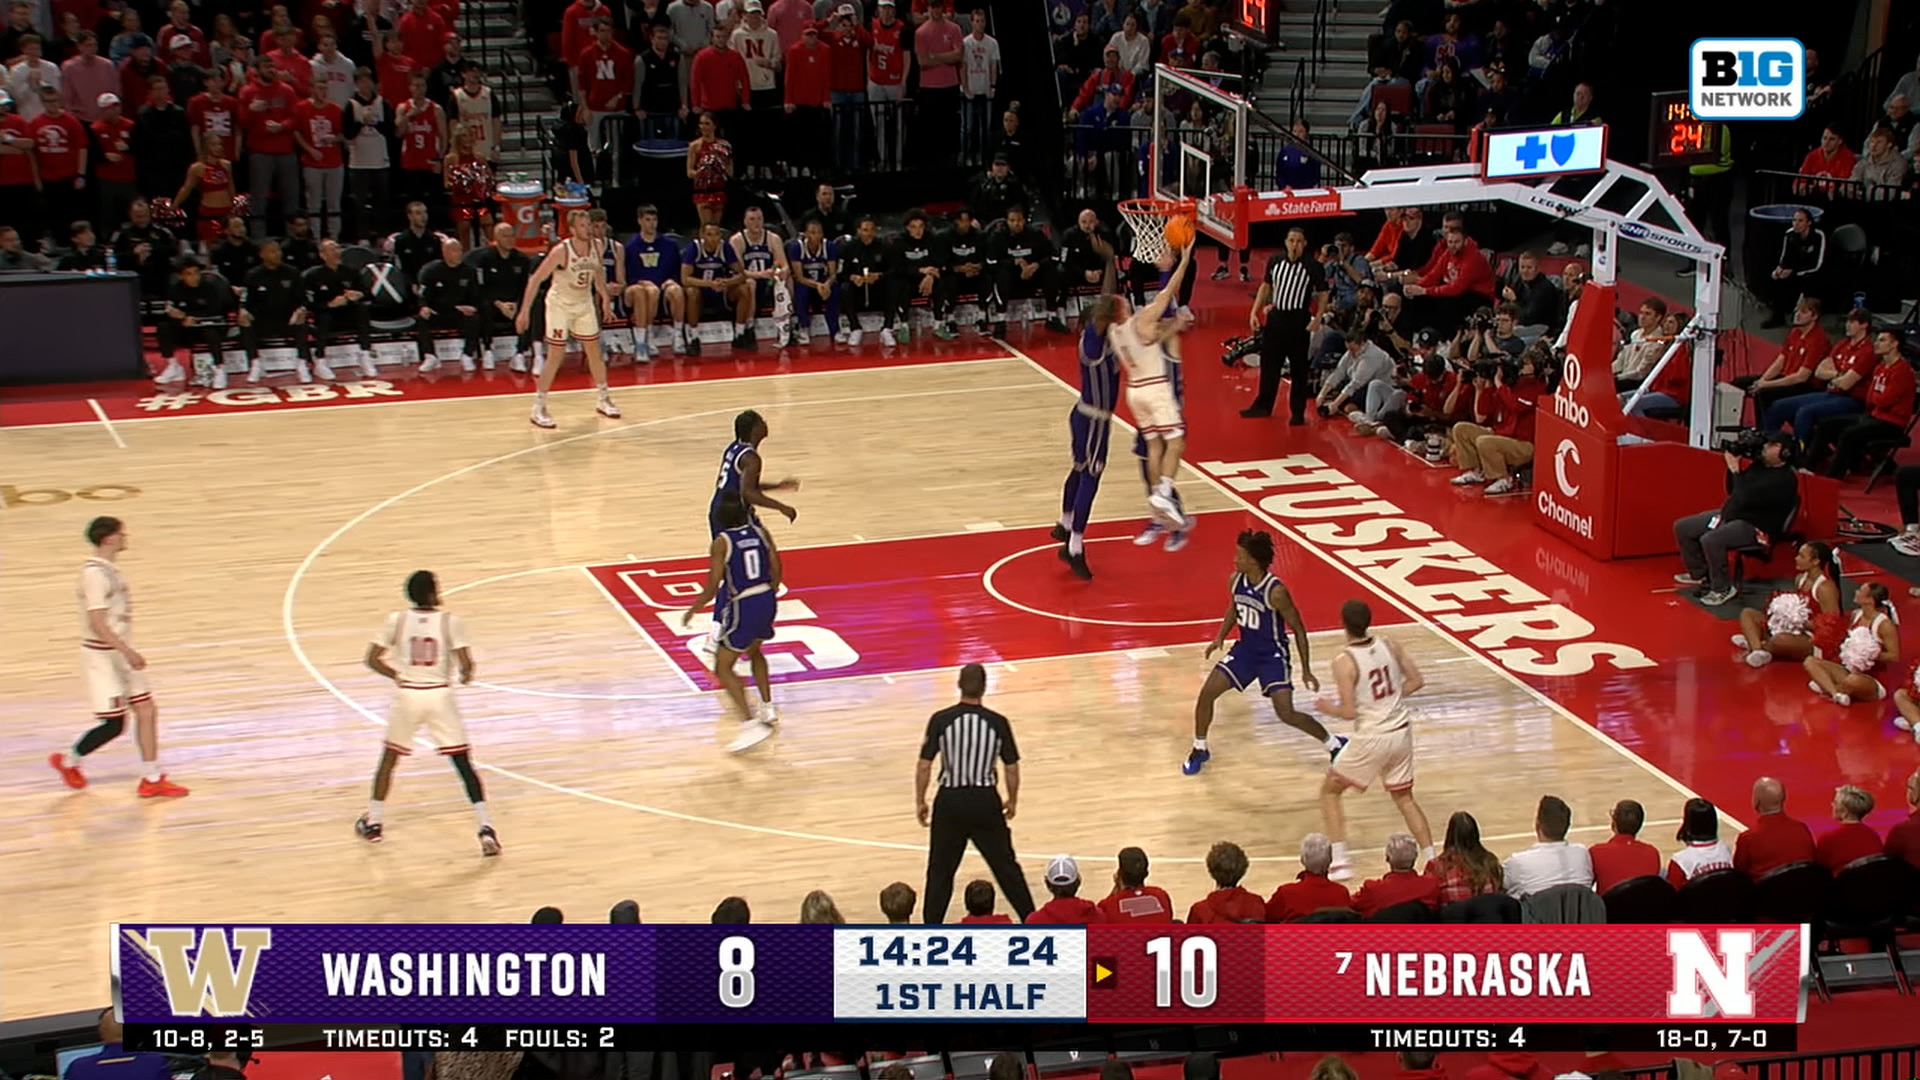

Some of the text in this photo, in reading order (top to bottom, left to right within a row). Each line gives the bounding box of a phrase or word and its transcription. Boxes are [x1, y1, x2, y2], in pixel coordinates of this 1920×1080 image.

[744, 38, 765, 59] N
[595, 60, 616, 80] N
[1668, 103, 1698, 121] 14:
[1671, 123, 1703, 153] 24
[517, 205, 534, 224] G
[1650, 232, 1702, 253] SPORTS
[776, 292, 785, 302] G
[552, 328, 564, 340] N
[136, 380, 405, 411] #GBR
[1553, 385, 1590, 429] fnbo
[1537, 490, 1593, 540] Channel
[743, 548, 762, 580] 0
[1198, 452, 1659, 676] HUSKERS
[1235, 604, 1261, 630] 30
[410, 636, 438, 667] 10
[1368, 664, 1396, 701] 21
